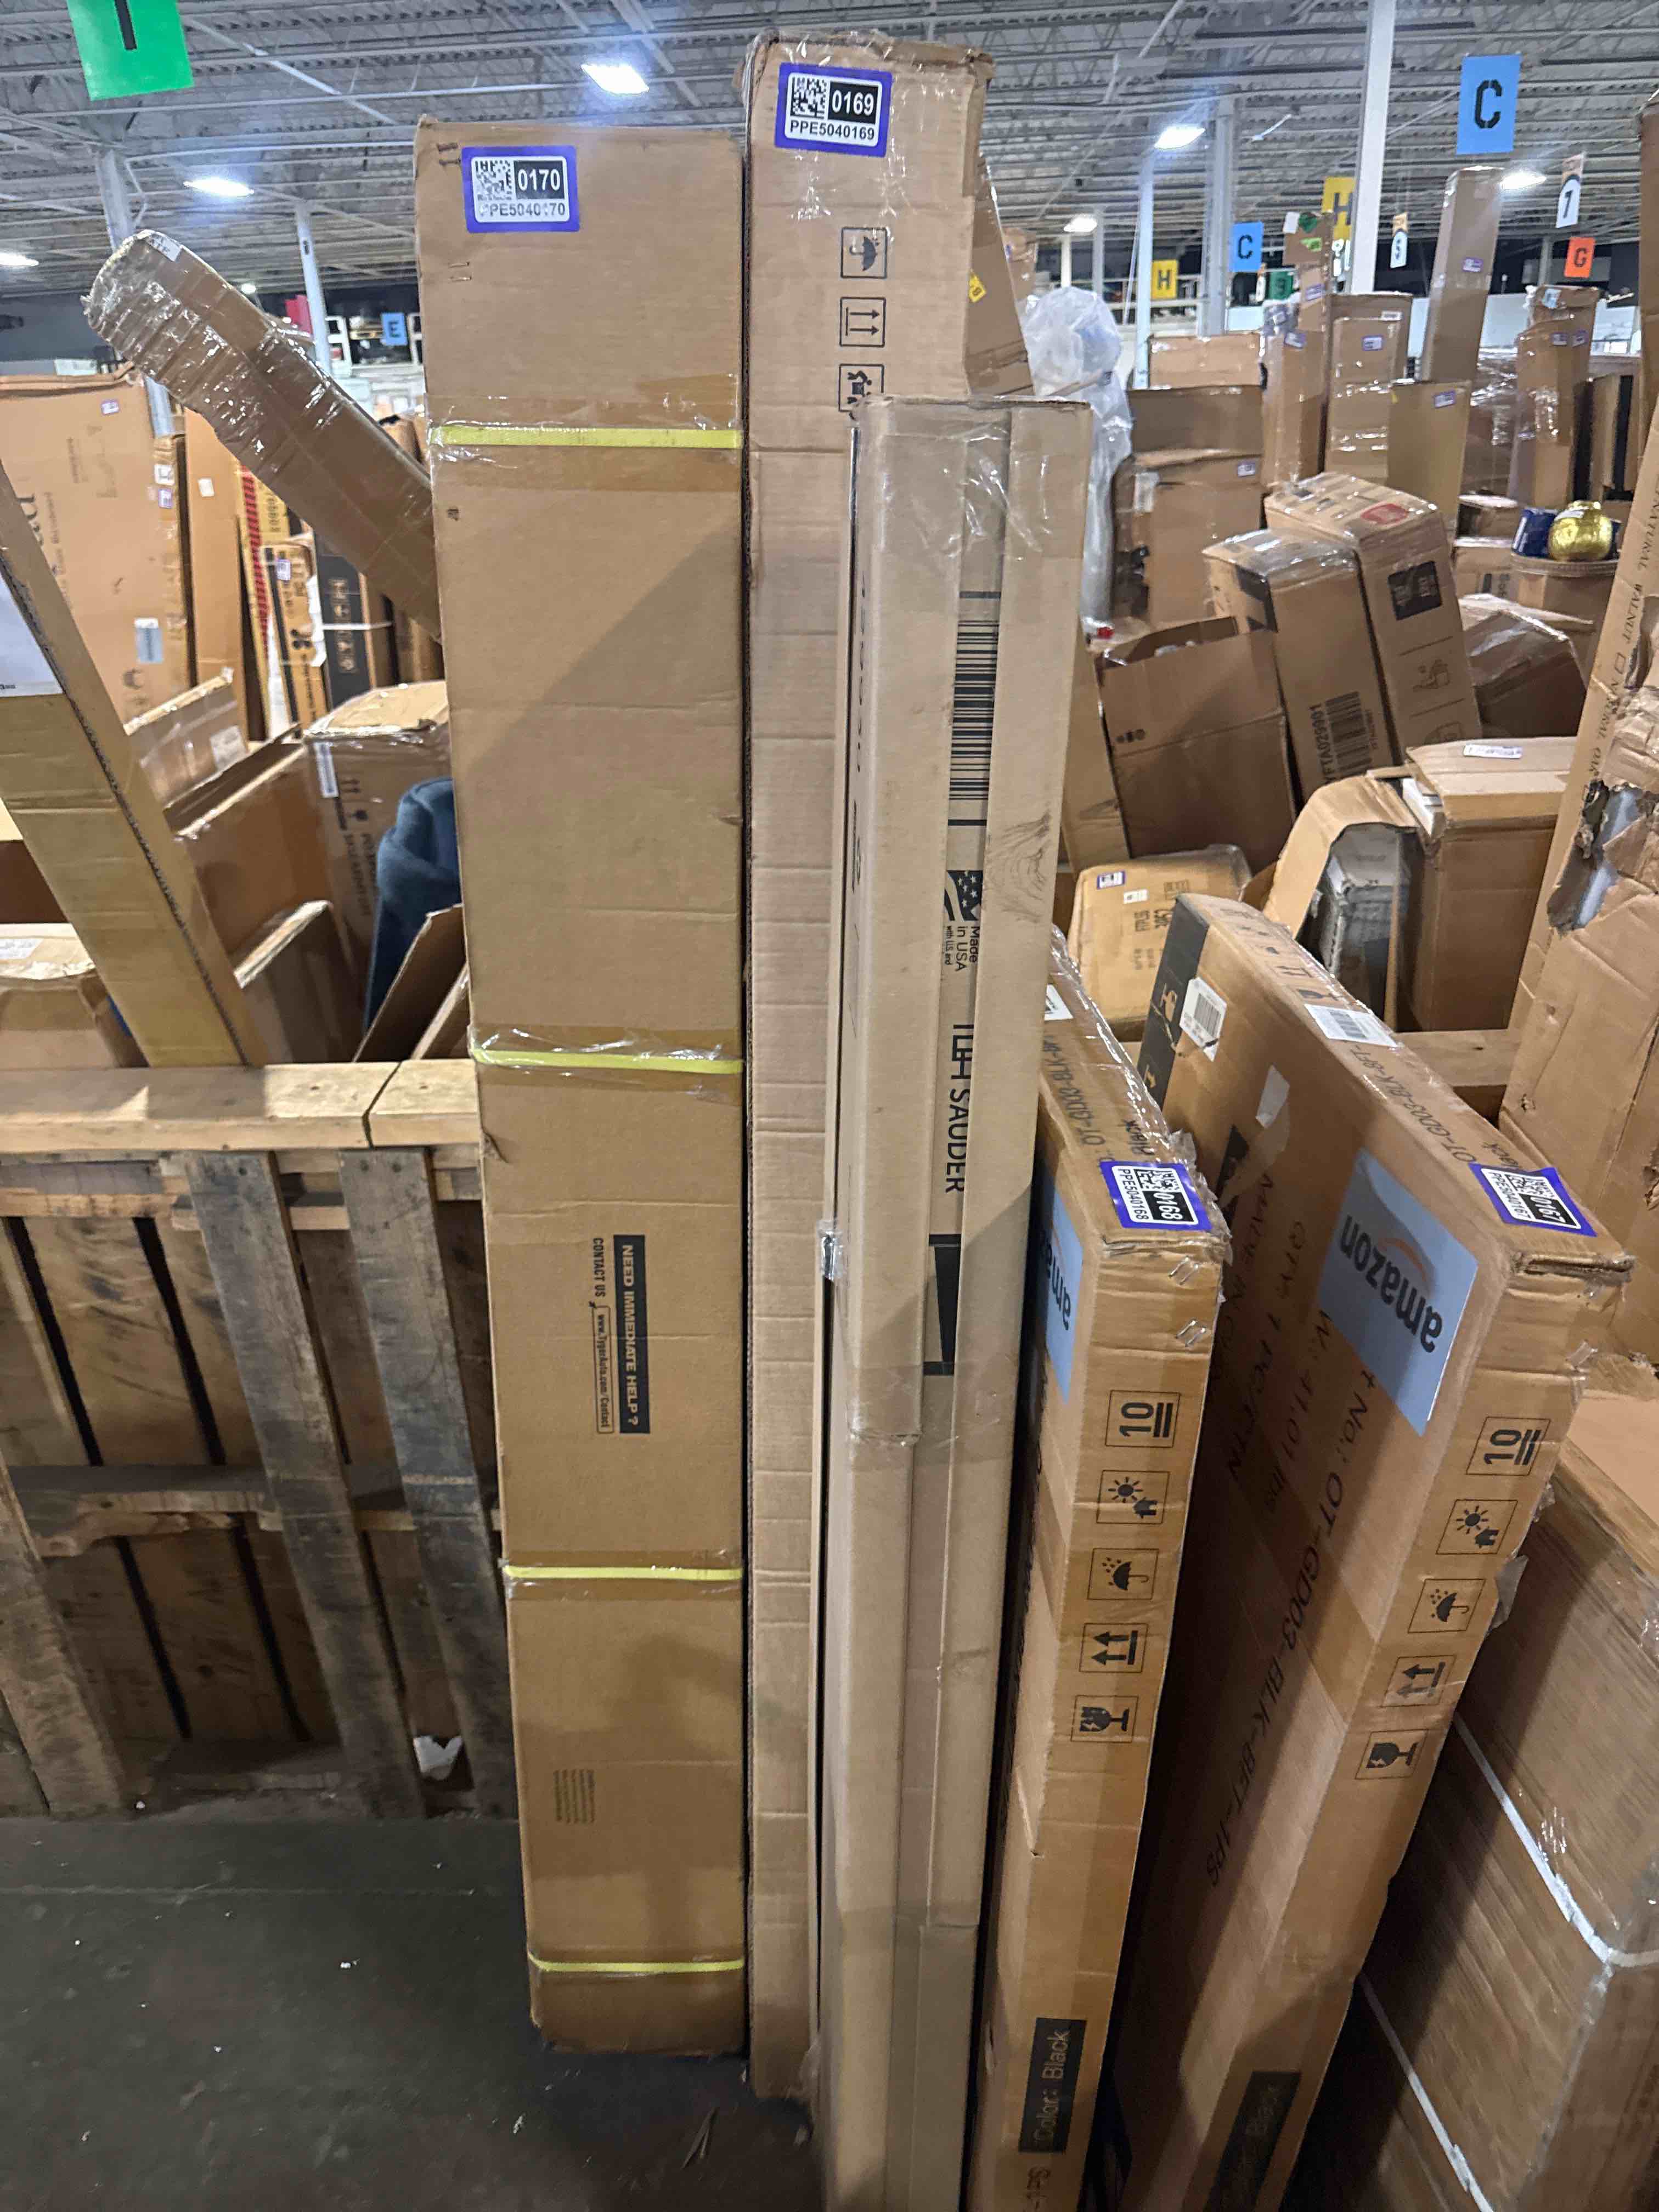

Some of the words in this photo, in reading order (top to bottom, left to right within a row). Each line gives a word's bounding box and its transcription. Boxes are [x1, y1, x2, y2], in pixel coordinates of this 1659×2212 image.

[831, 89, 874, 117] 0169
[1474, 79, 1503, 129] C
[790, 119, 875, 141] PPE5040169
[517, 168, 561, 191] 0170
[1237, 234, 1253, 259] C
[1157, 269, 1172, 290] H
[946, 926, 954, 939] with
[956, 926, 968, 938] in
[969, 926, 980, 963] Made
[944, 953, 953, 966] and
[955, 941, 968, 972] USA
[945, 1088, 970, 1194] SAUDER
[1118, 1168, 1149, 1221] PPE5040168
[1153, 1192, 1183, 1220] 0168
[1530, 1196, 1567, 1224] 0167
[592, 1237, 606, 1281] CONTACT
[622, 1244, 634, 1286] NEED
[594, 1284, 607, 1297] US
[1340, 1215, 1443, 1353] amazon
[623, 1291, 637, 1372] IMMEDIATE
[595, 1314, 610, 1428] www.TygerAuto.com/Contact
[626, 1375, 638, 1414] HELP
[1119, 1401, 1154, 1437] 10
[1483, 1429, 1522, 1465] 10
[1042, 2028, 1071, 2080] Black
